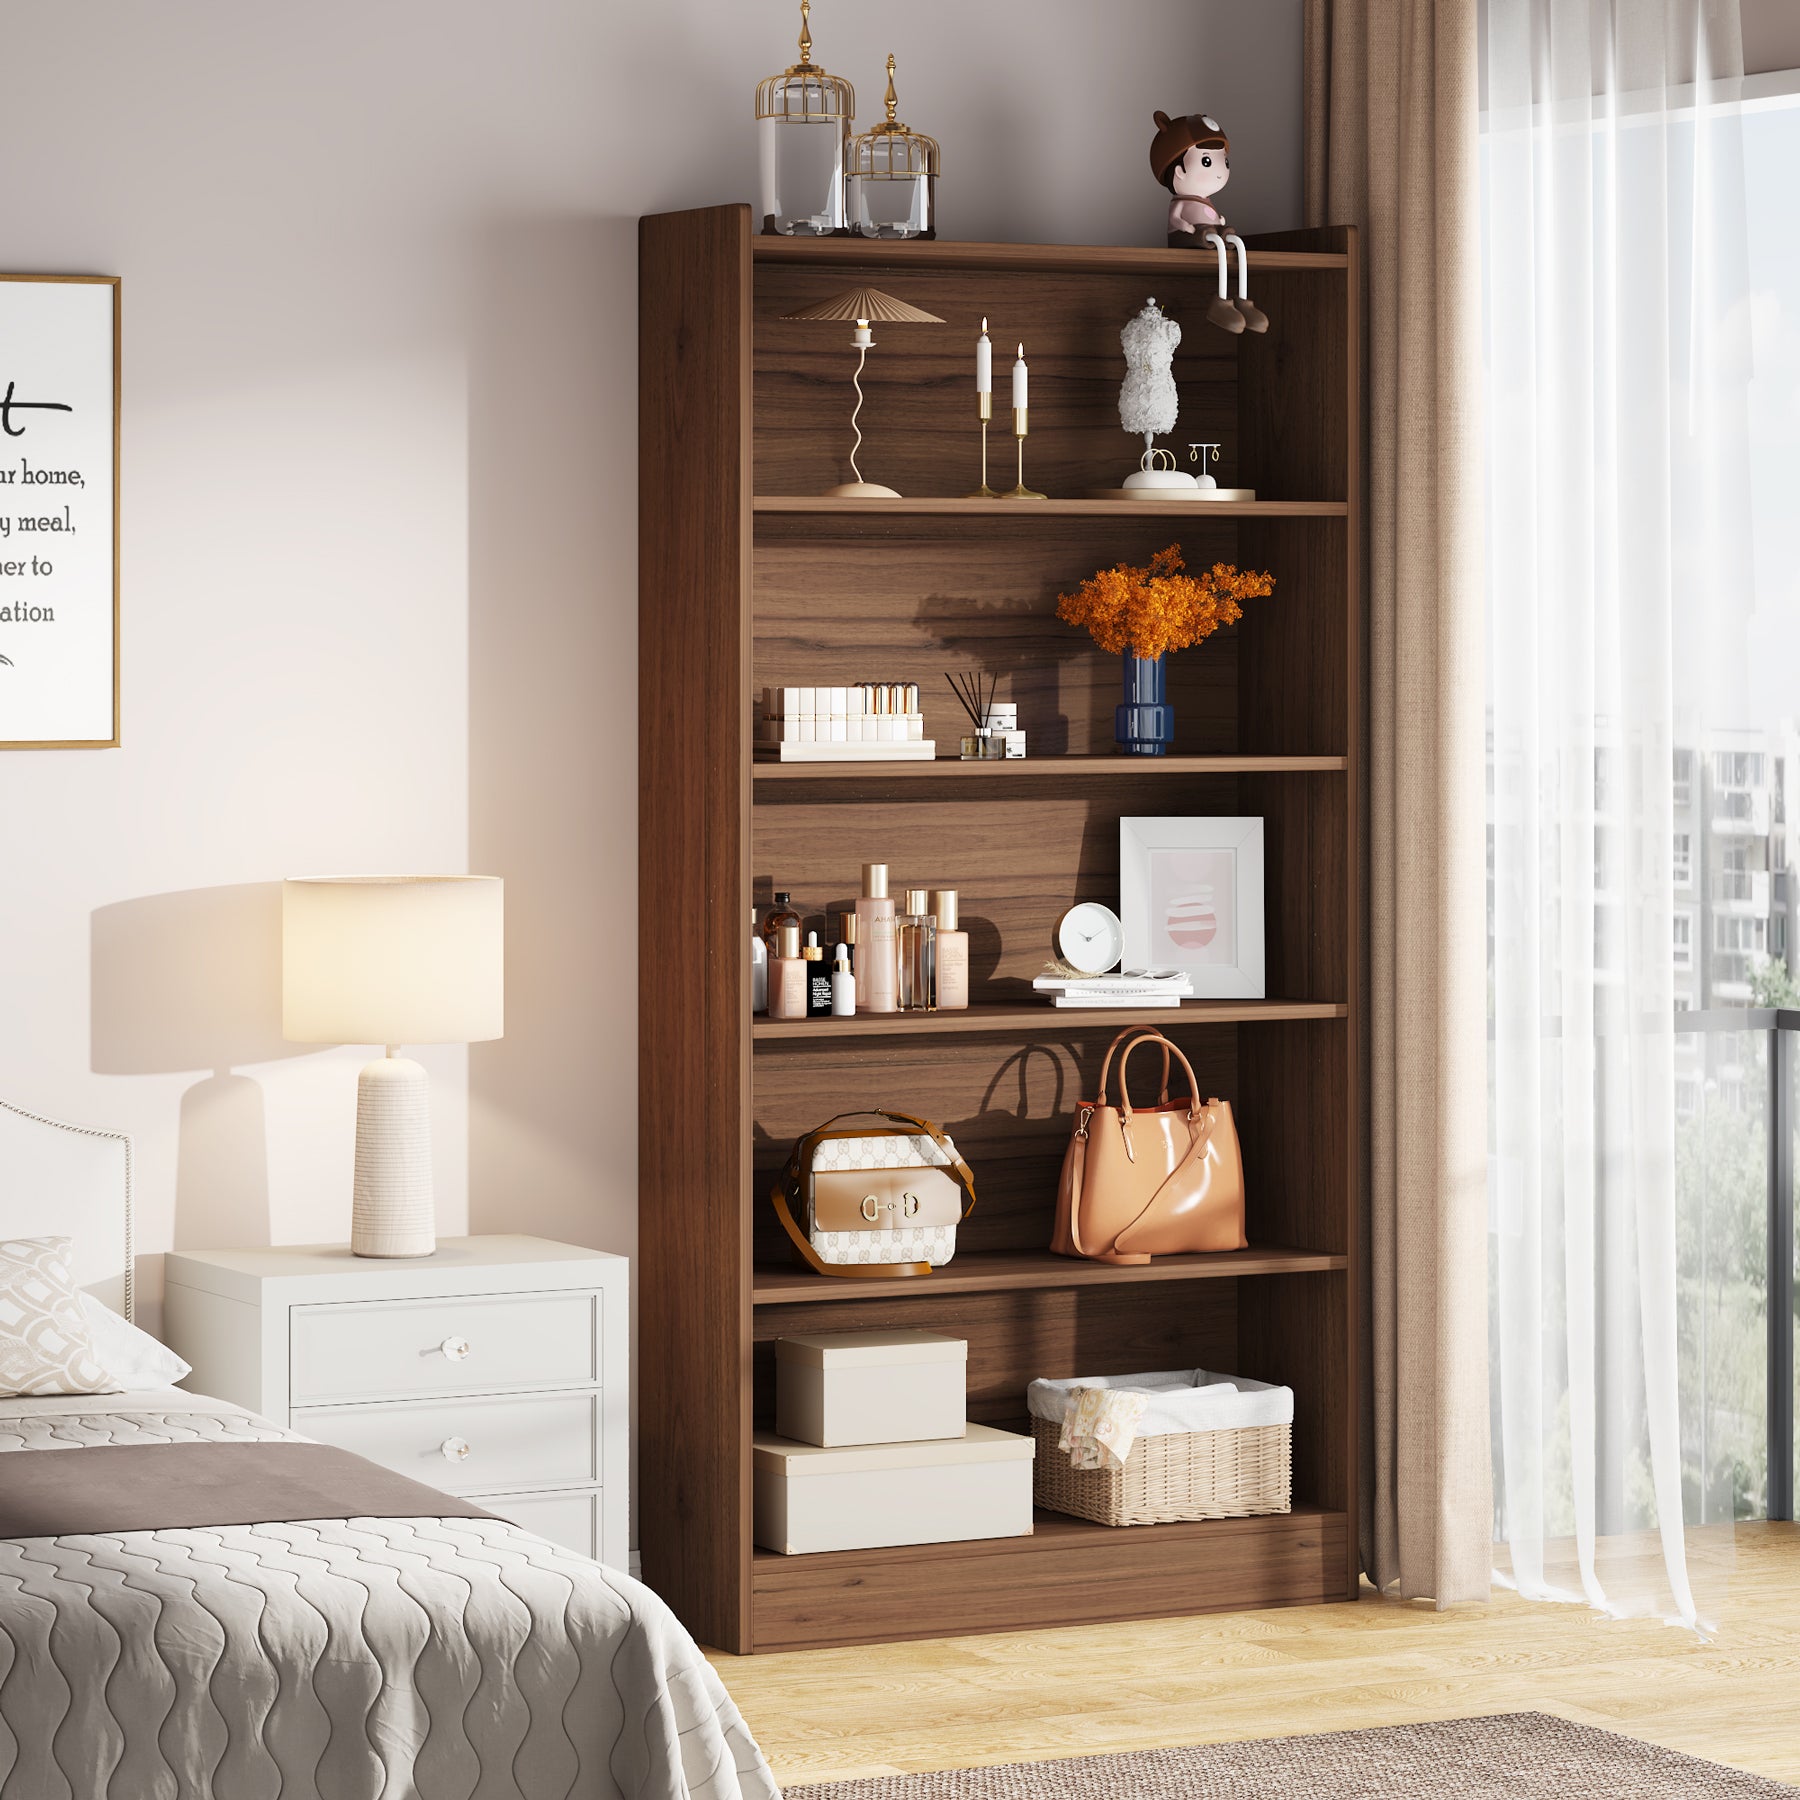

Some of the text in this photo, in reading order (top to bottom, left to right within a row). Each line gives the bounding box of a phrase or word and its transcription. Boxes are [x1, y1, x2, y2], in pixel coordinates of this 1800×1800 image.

[21, 457, 85, 489] home,
[18, 505, 76, 535] meal,
[31, 555, 53, 576] to
